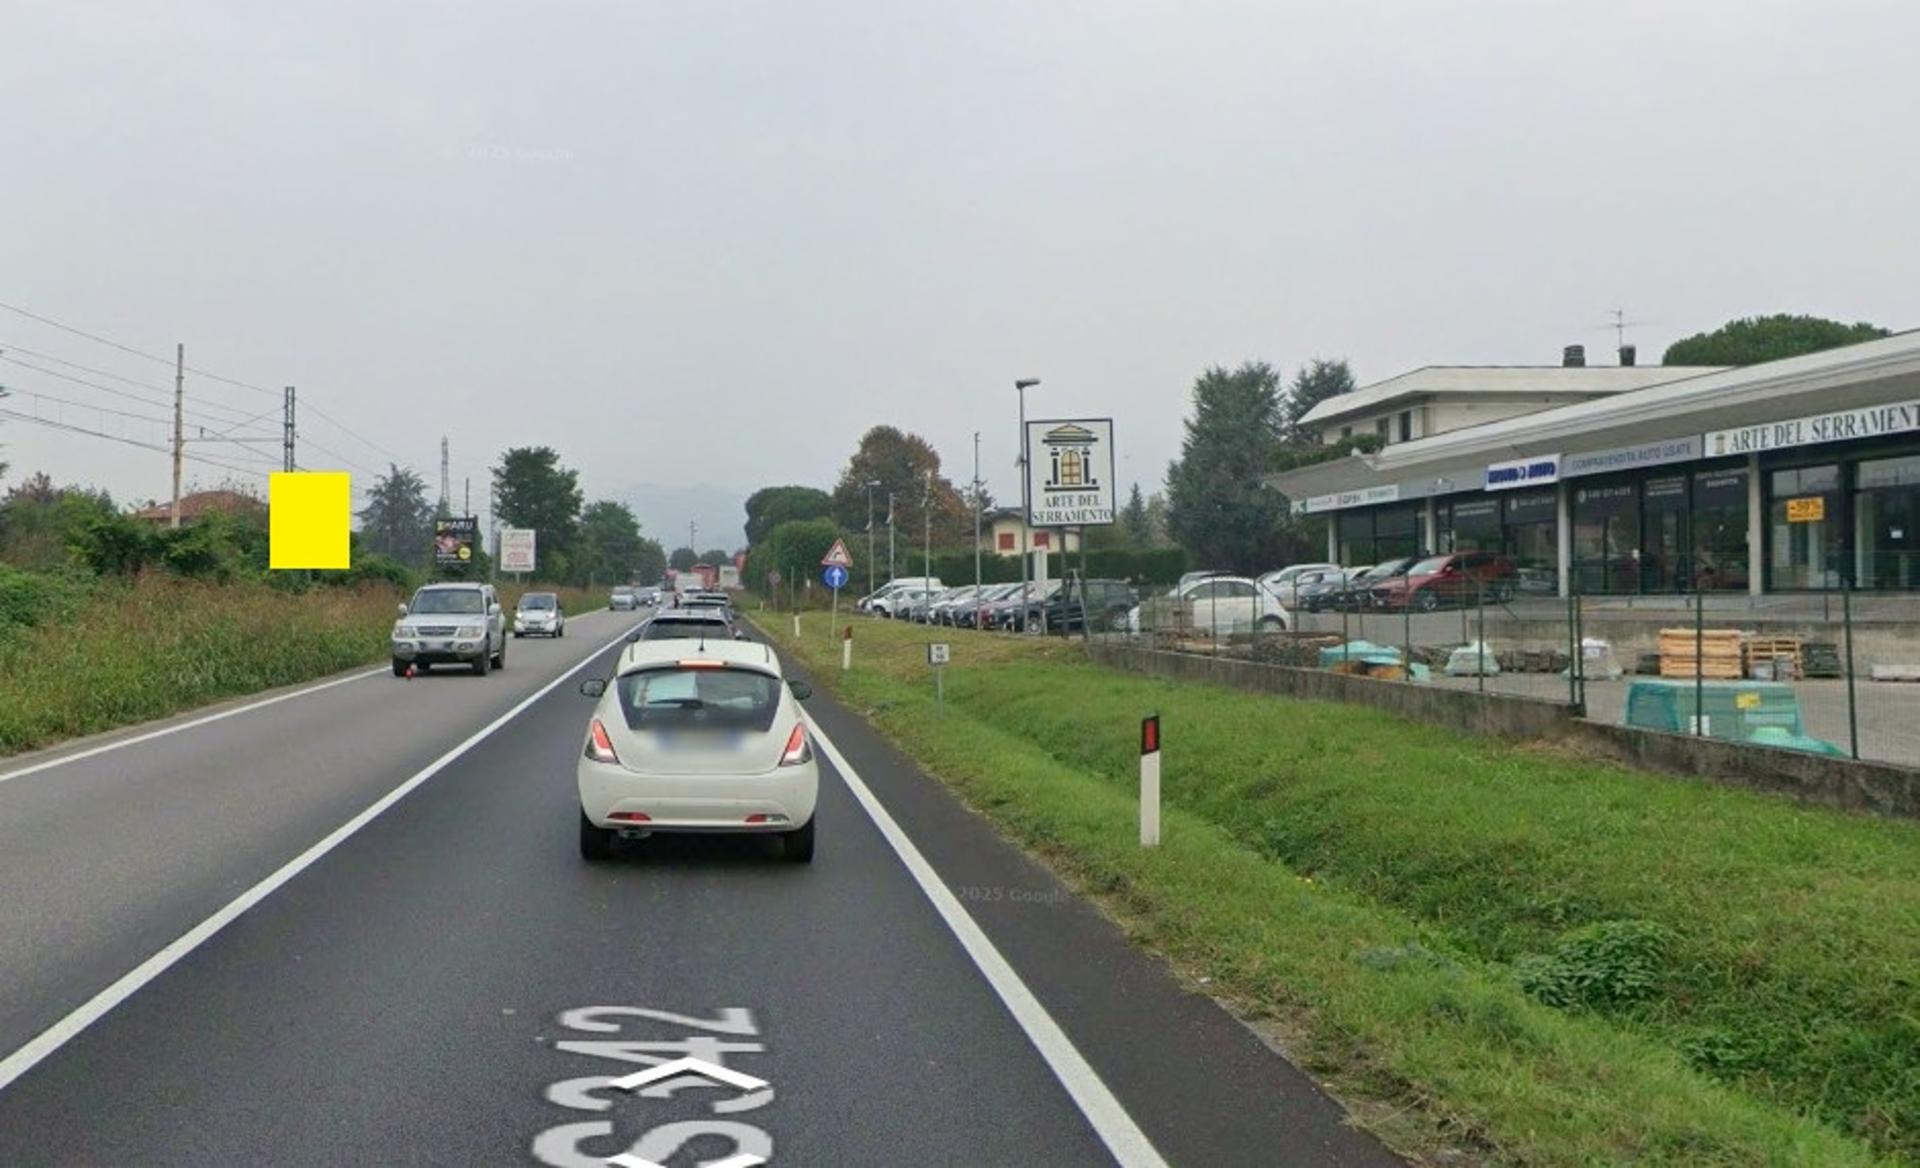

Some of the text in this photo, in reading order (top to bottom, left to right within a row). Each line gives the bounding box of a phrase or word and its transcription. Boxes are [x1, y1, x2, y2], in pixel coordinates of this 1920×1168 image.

[1729, 425, 1772, 452] ARTE
[1774, 421, 1805, 447] DEL
[1638, 446, 1661, 460] AUTO
[1663, 441, 1692, 457] USATE
[1045, 494, 1102, 508] ARTE DEL
[1032, 508, 1113, 523] SERRAMENTO
